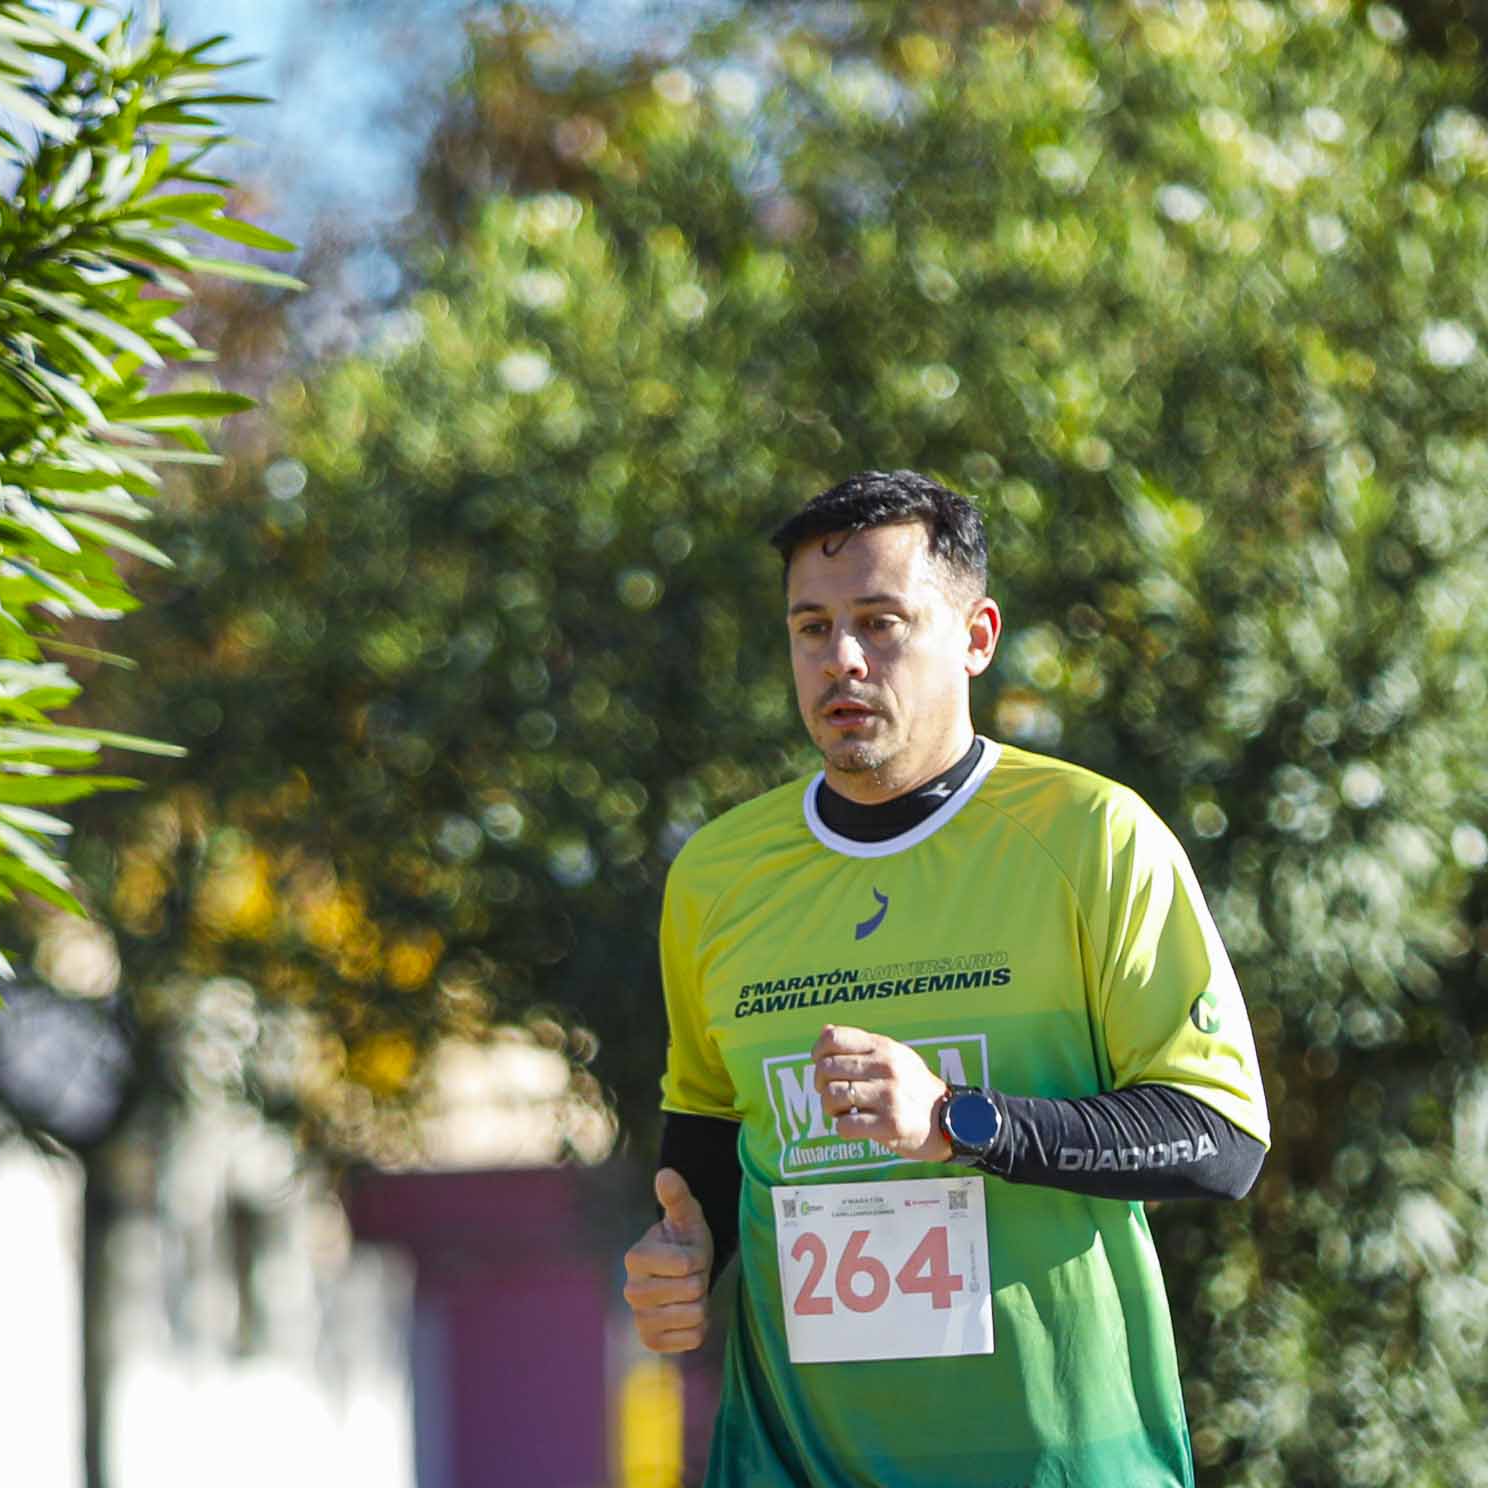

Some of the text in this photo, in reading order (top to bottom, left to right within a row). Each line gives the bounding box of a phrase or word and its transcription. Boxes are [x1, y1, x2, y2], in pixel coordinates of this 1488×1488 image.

[735, 968, 1012, 1019] CAWILLIAMSKEMMIS
[1057, 1133, 1219, 1172] DIADORA
[790, 1226, 964, 1316] 264
